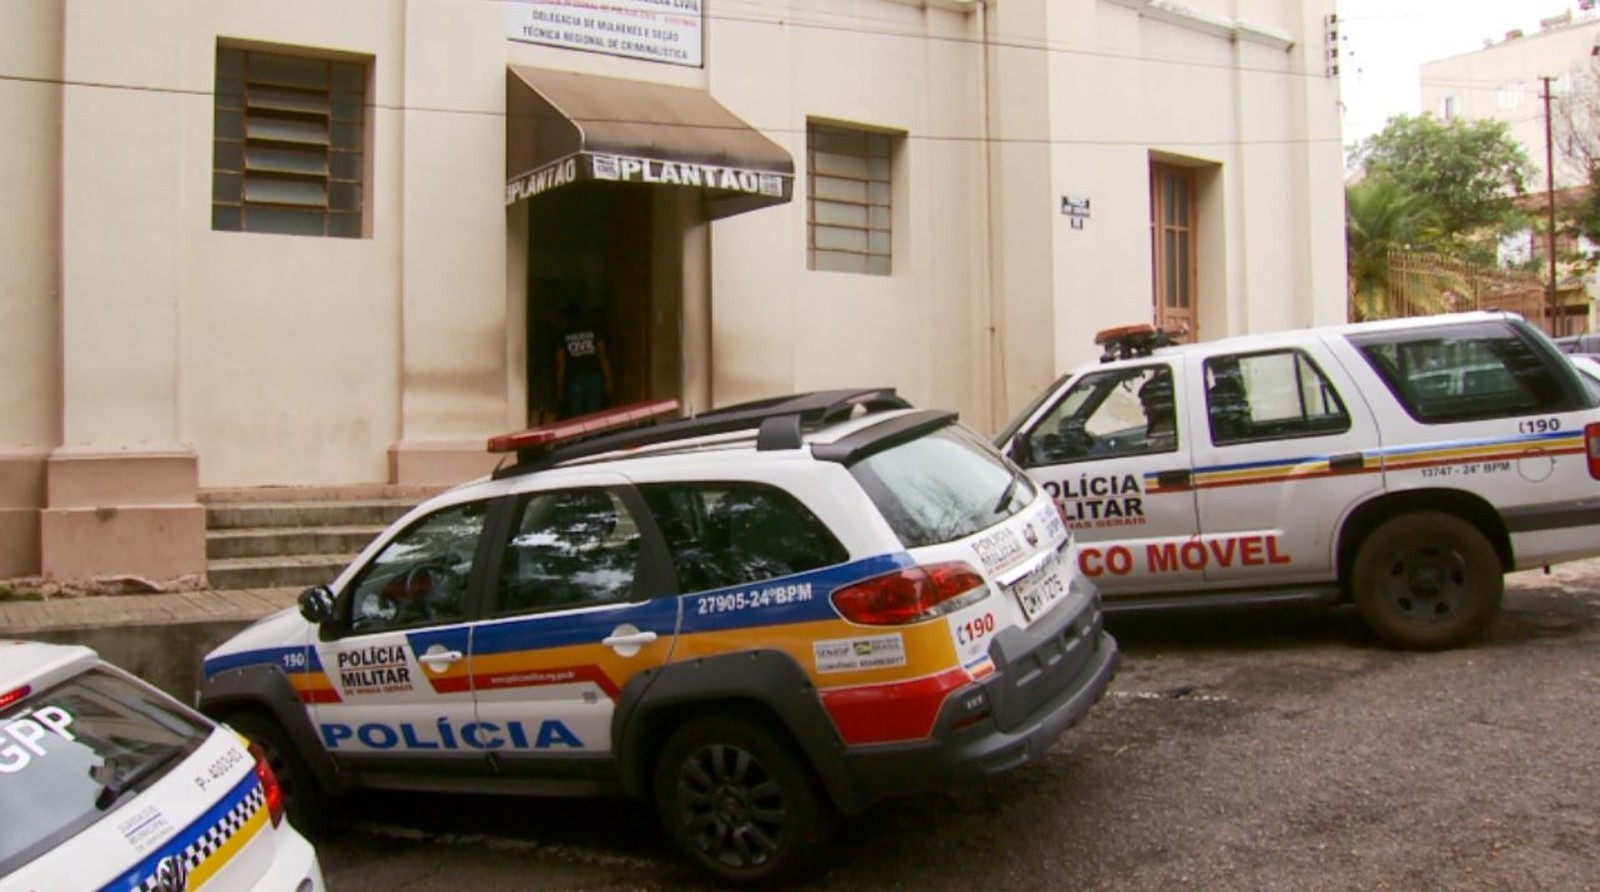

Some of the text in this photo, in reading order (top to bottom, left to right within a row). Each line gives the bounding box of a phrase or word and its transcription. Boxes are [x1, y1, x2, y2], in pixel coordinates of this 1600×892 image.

[584, 18, 595, 29] DE
[597, 20, 643, 37] MULHERES
[563, 31, 605, 47] REGIONAL
[607, 38, 618, 49] DE
[1525, 418, 1560, 433] 190
[1483, 462, 1510, 473] BPM
[1043, 473, 1140, 498] OLÍCIA
[1062, 498, 1144, 520] LITAR
[965, 613, 994, 641] 190
[283, 653, 305, 667] 190
[338, 646, 406, 668] POLÍCIA
[342, 667, 410, 688] MILITAR
[0, 706, 75, 773] GPP
[320, 717, 585, 749] POLÍCIA
